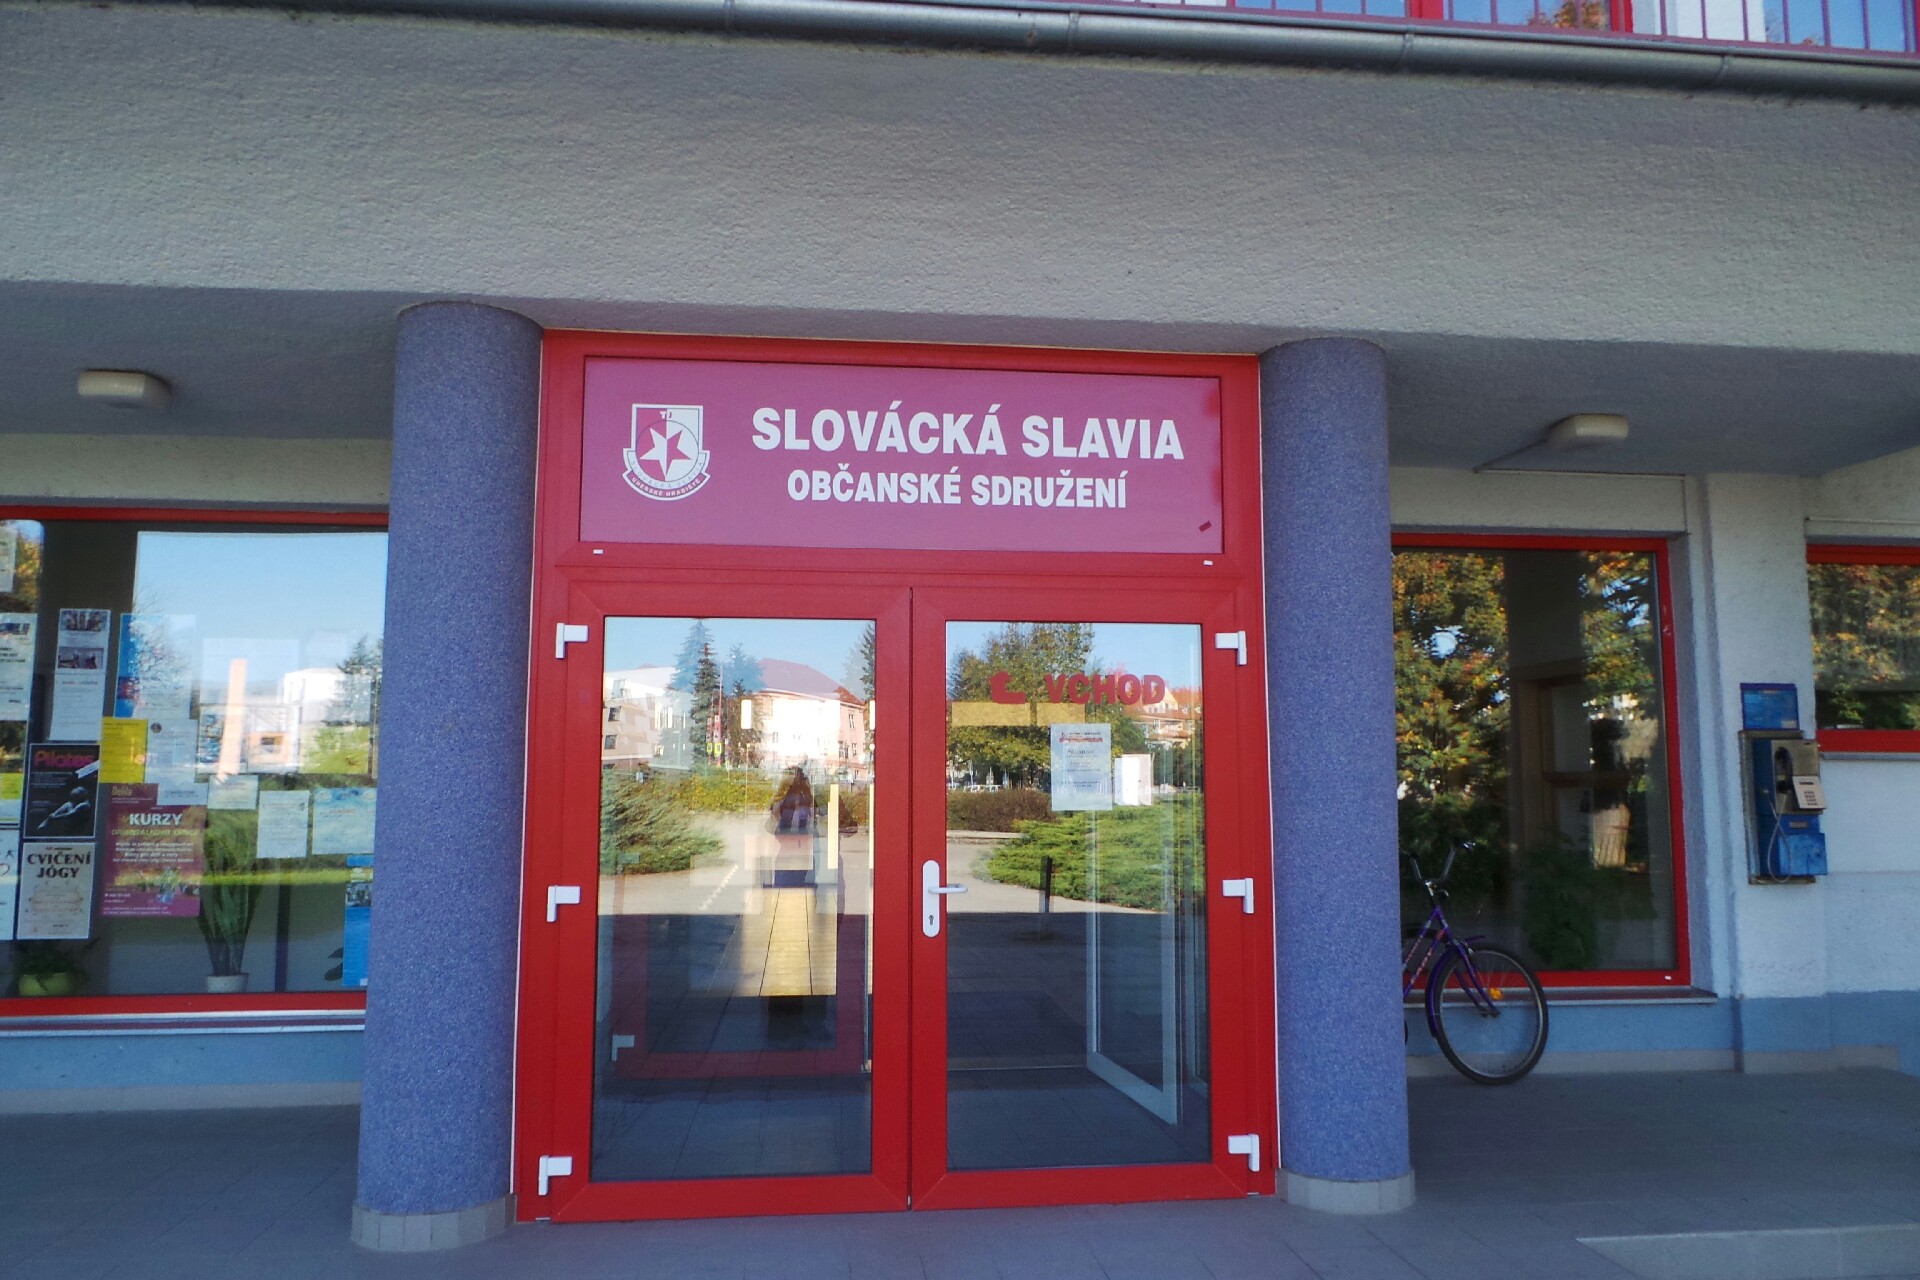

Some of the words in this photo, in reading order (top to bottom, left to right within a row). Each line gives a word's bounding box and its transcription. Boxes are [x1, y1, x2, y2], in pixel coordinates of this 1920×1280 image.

[660, 411, 672, 419] TJ
[752, 400, 1008, 456] SLOVÁCKÁ
[1021, 415, 1185, 460] SLAVIA
[787, 462, 962, 505] OBČANSKÉ
[971, 469, 1129, 509] SDRUŽENÍ
[1044, 674, 1165, 705] VCHOD
[129, 813, 182, 826] KURZY
[27, 851, 91, 865] CVIČENÍ
[36, 864, 80, 879] JÓGY
